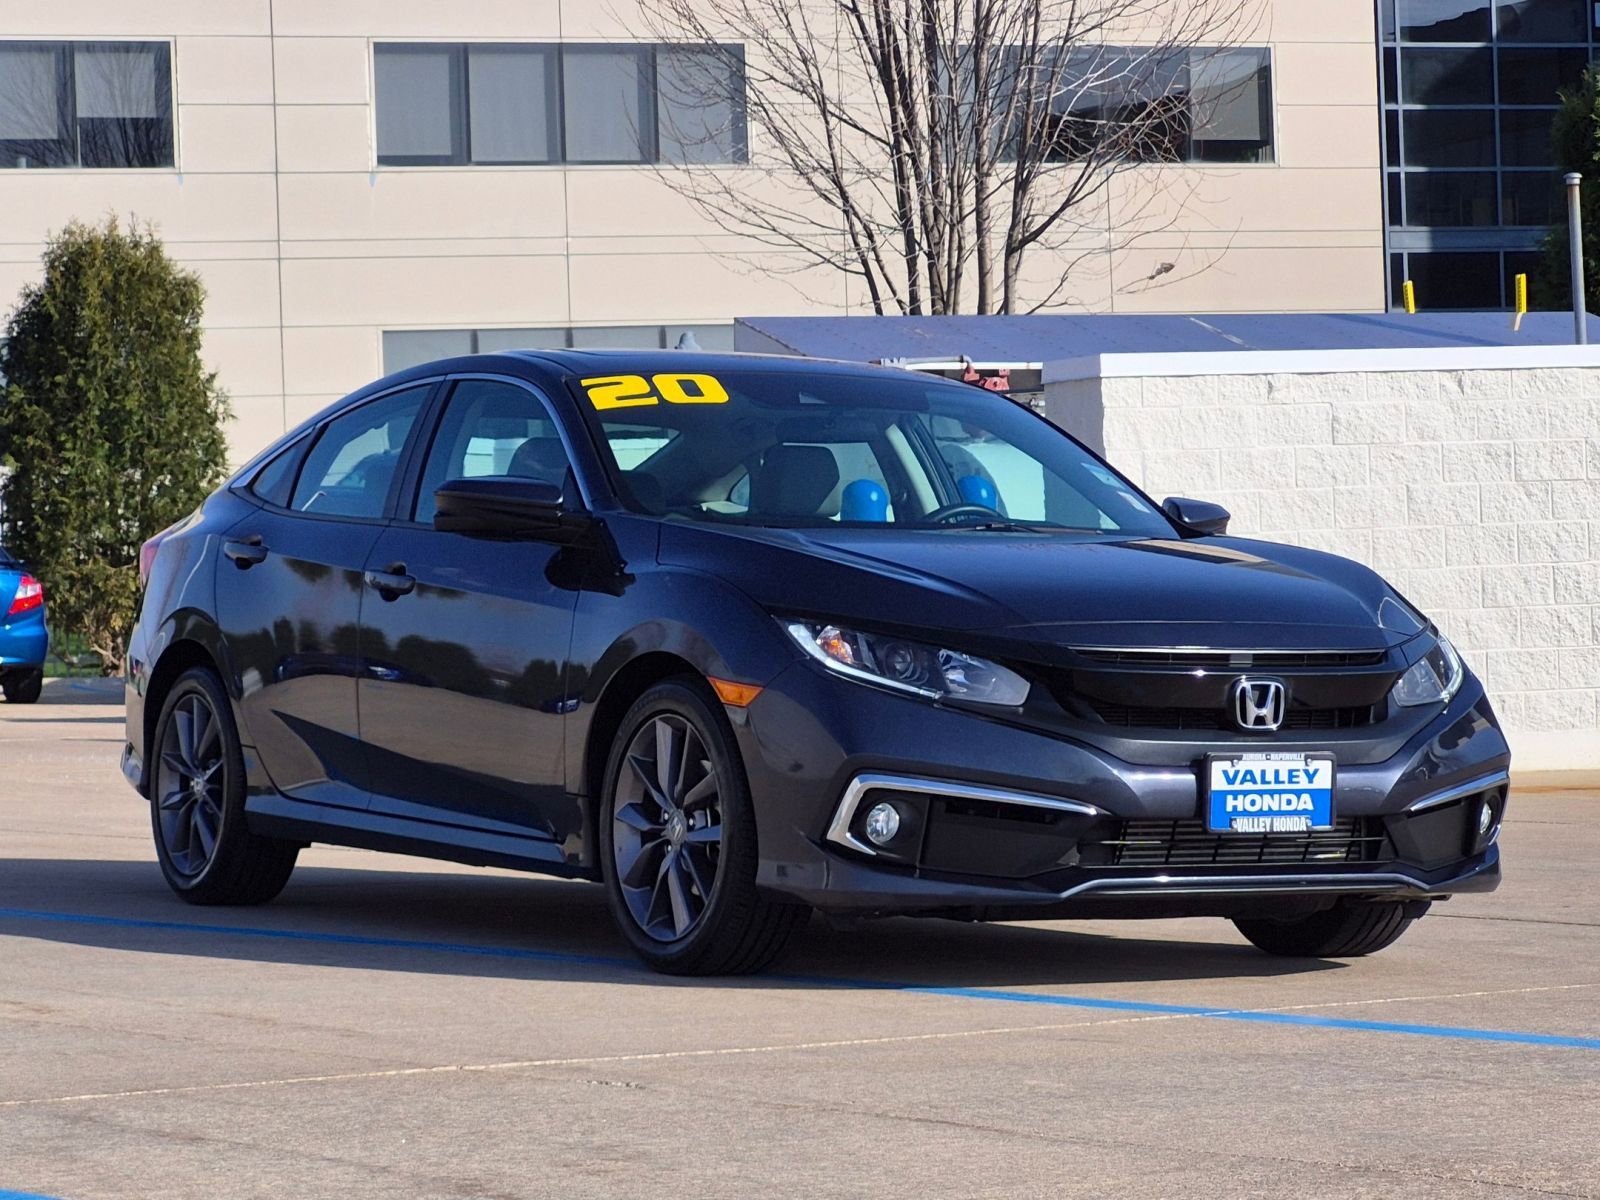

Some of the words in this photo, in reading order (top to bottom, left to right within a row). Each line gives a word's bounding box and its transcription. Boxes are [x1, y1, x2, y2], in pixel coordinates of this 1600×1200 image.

[580, 373, 729, 410] 20
[1222, 768, 1319, 785] VALLEY
[1226, 793, 1314, 812] HONDA
[1236, 817, 1271, 832] VALLEY
[1273, 817, 1307, 831] HONDA
